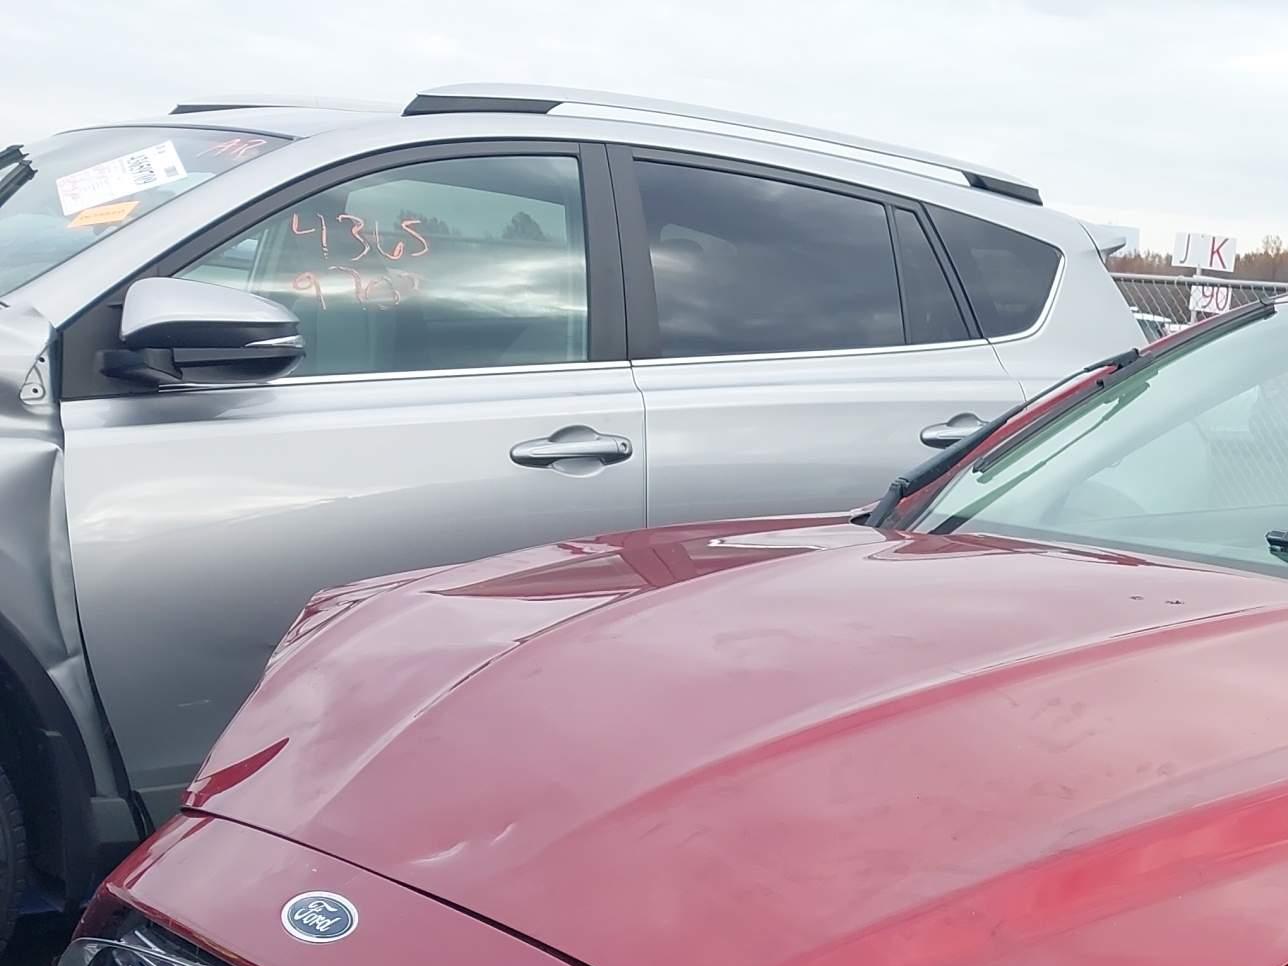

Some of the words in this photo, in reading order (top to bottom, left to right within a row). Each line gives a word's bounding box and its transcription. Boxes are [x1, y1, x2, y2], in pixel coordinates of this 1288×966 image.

[292, 212, 429, 260] 4365
[1179, 233, 1191, 263] J
[1209, 236, 1229, 269] K
[1201, 284, 1230, 311] 90
[293, 900, 342, 932] Ford
